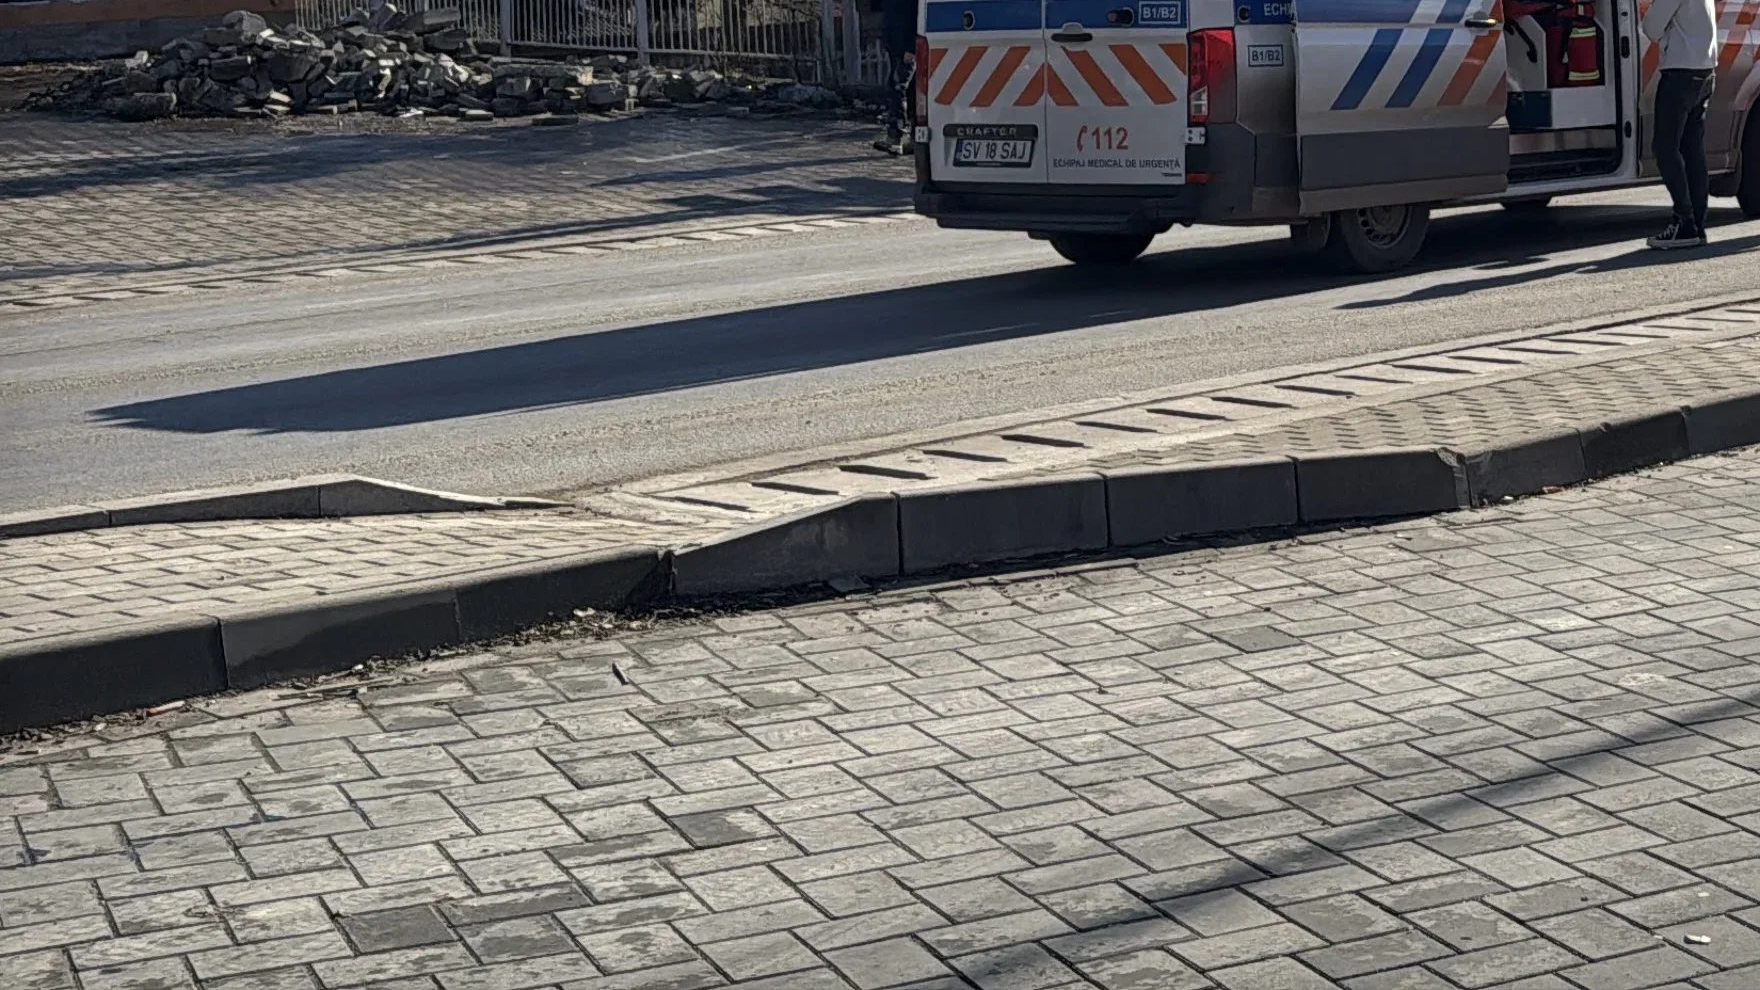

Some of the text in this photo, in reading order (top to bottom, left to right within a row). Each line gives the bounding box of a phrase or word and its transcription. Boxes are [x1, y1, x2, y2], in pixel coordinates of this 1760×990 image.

[1142, 6, 1177, 19] B1/B2
[1251, 49, 1281, 62] B1/B2
[957, 127, 1017, 136] CRAFTER
[1091, 127, 1129, 151] 112
[963, 141, 1027, 160] SV 18 SAJ
[1053, 158, 1085, 169] ECHIPAJ
[1087, 159, 1123, 169] MEDICAL
[1125, 159, 1137, 169] DE
